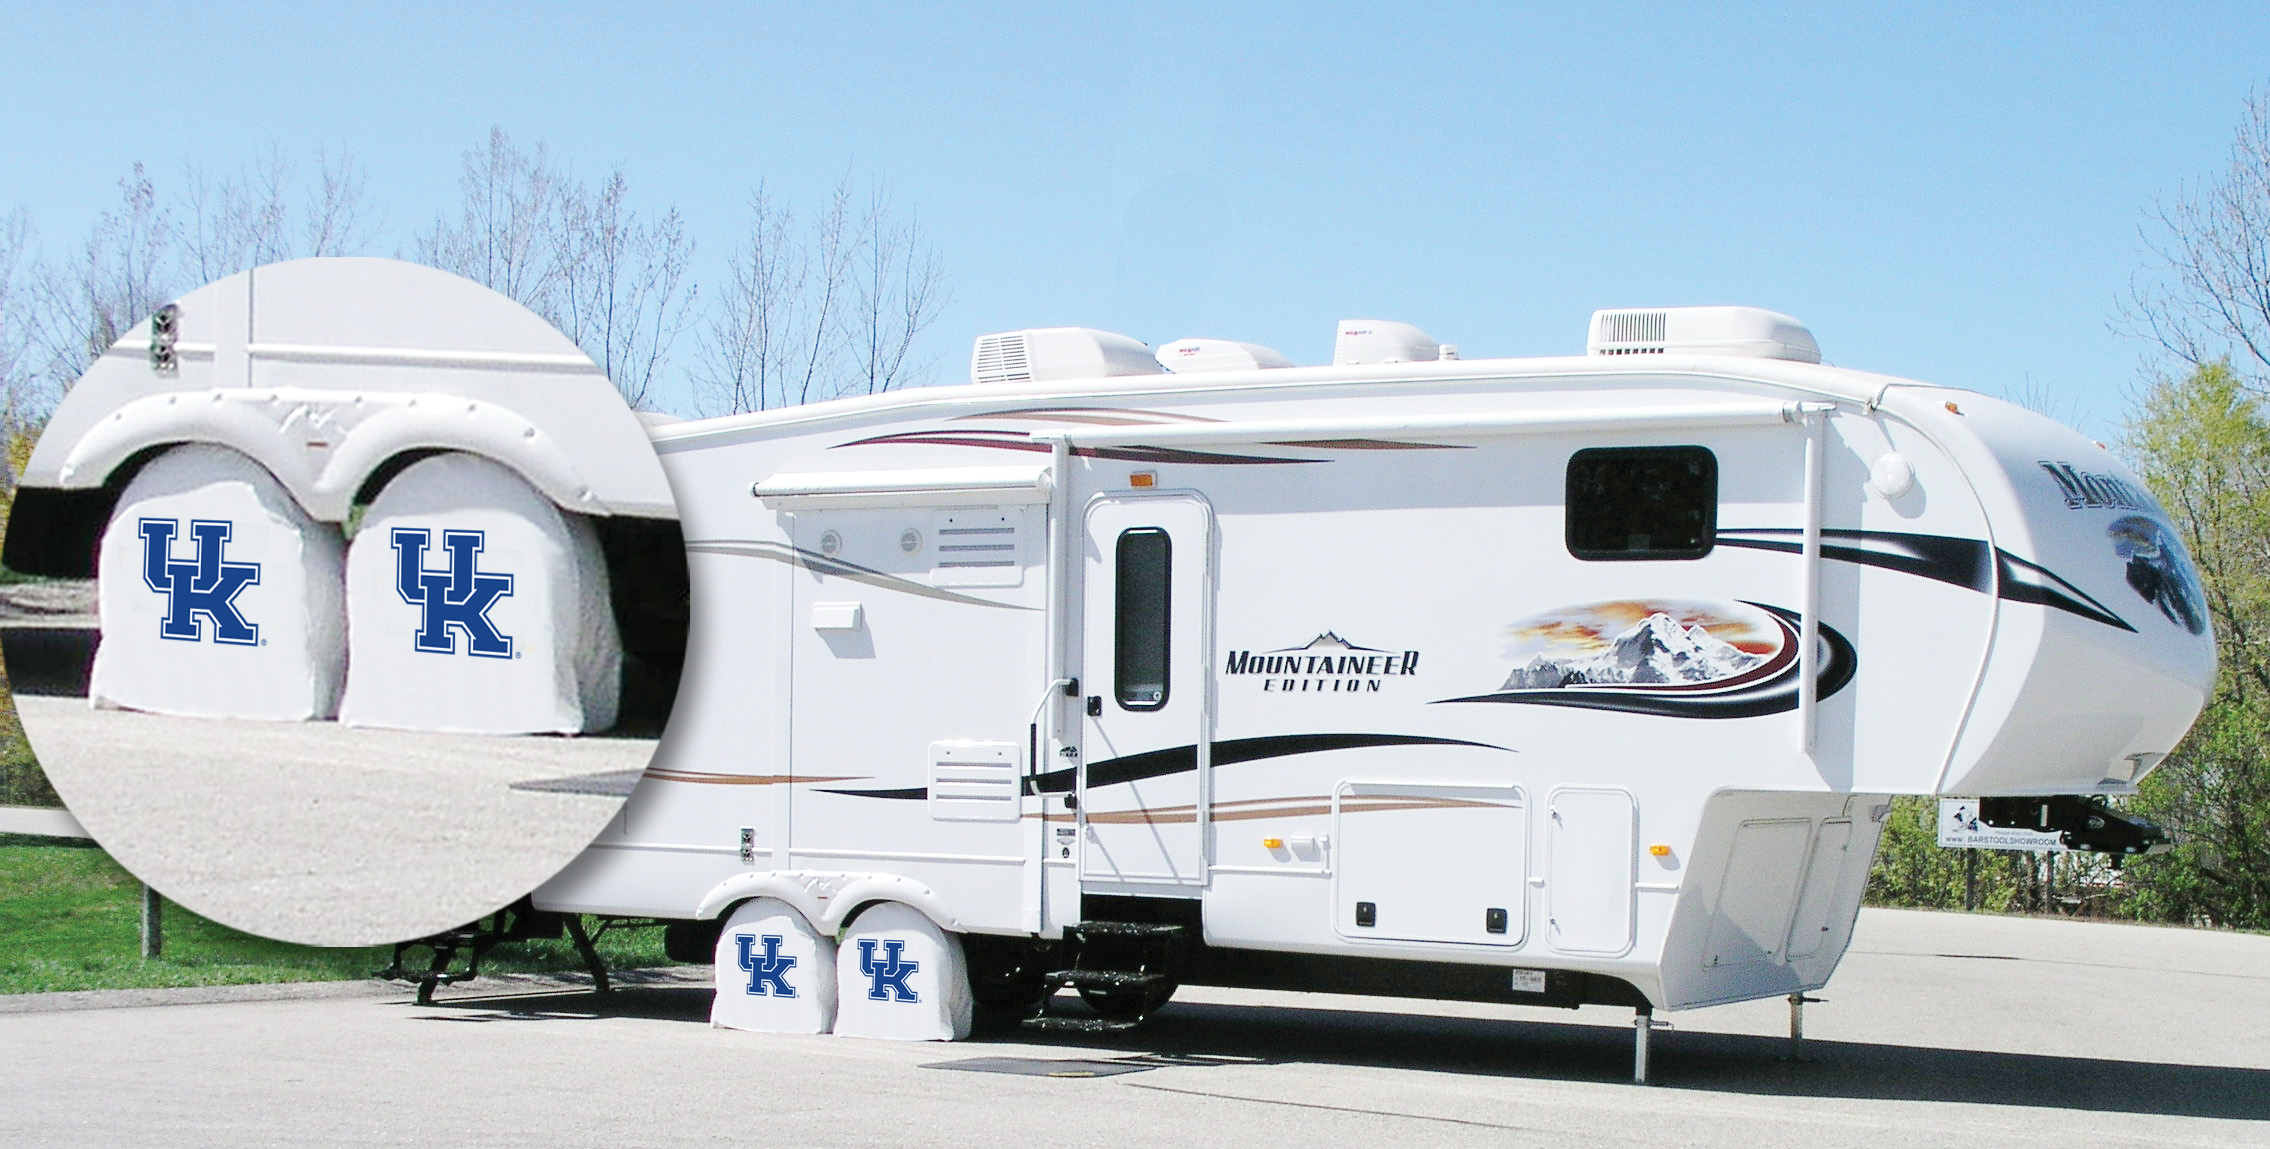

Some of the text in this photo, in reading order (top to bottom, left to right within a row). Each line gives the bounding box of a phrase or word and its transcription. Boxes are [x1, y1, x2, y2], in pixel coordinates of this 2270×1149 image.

[138, 517, 261, 647] UK
[391, 527, 514, 660] UK
[1225, 650, 1420, 676] MOUNTAINEER
[1263, 678, 1381, 693] EDITION
[735, 933, 797, 999] UK
[857, 938, 919, 1004] UK
